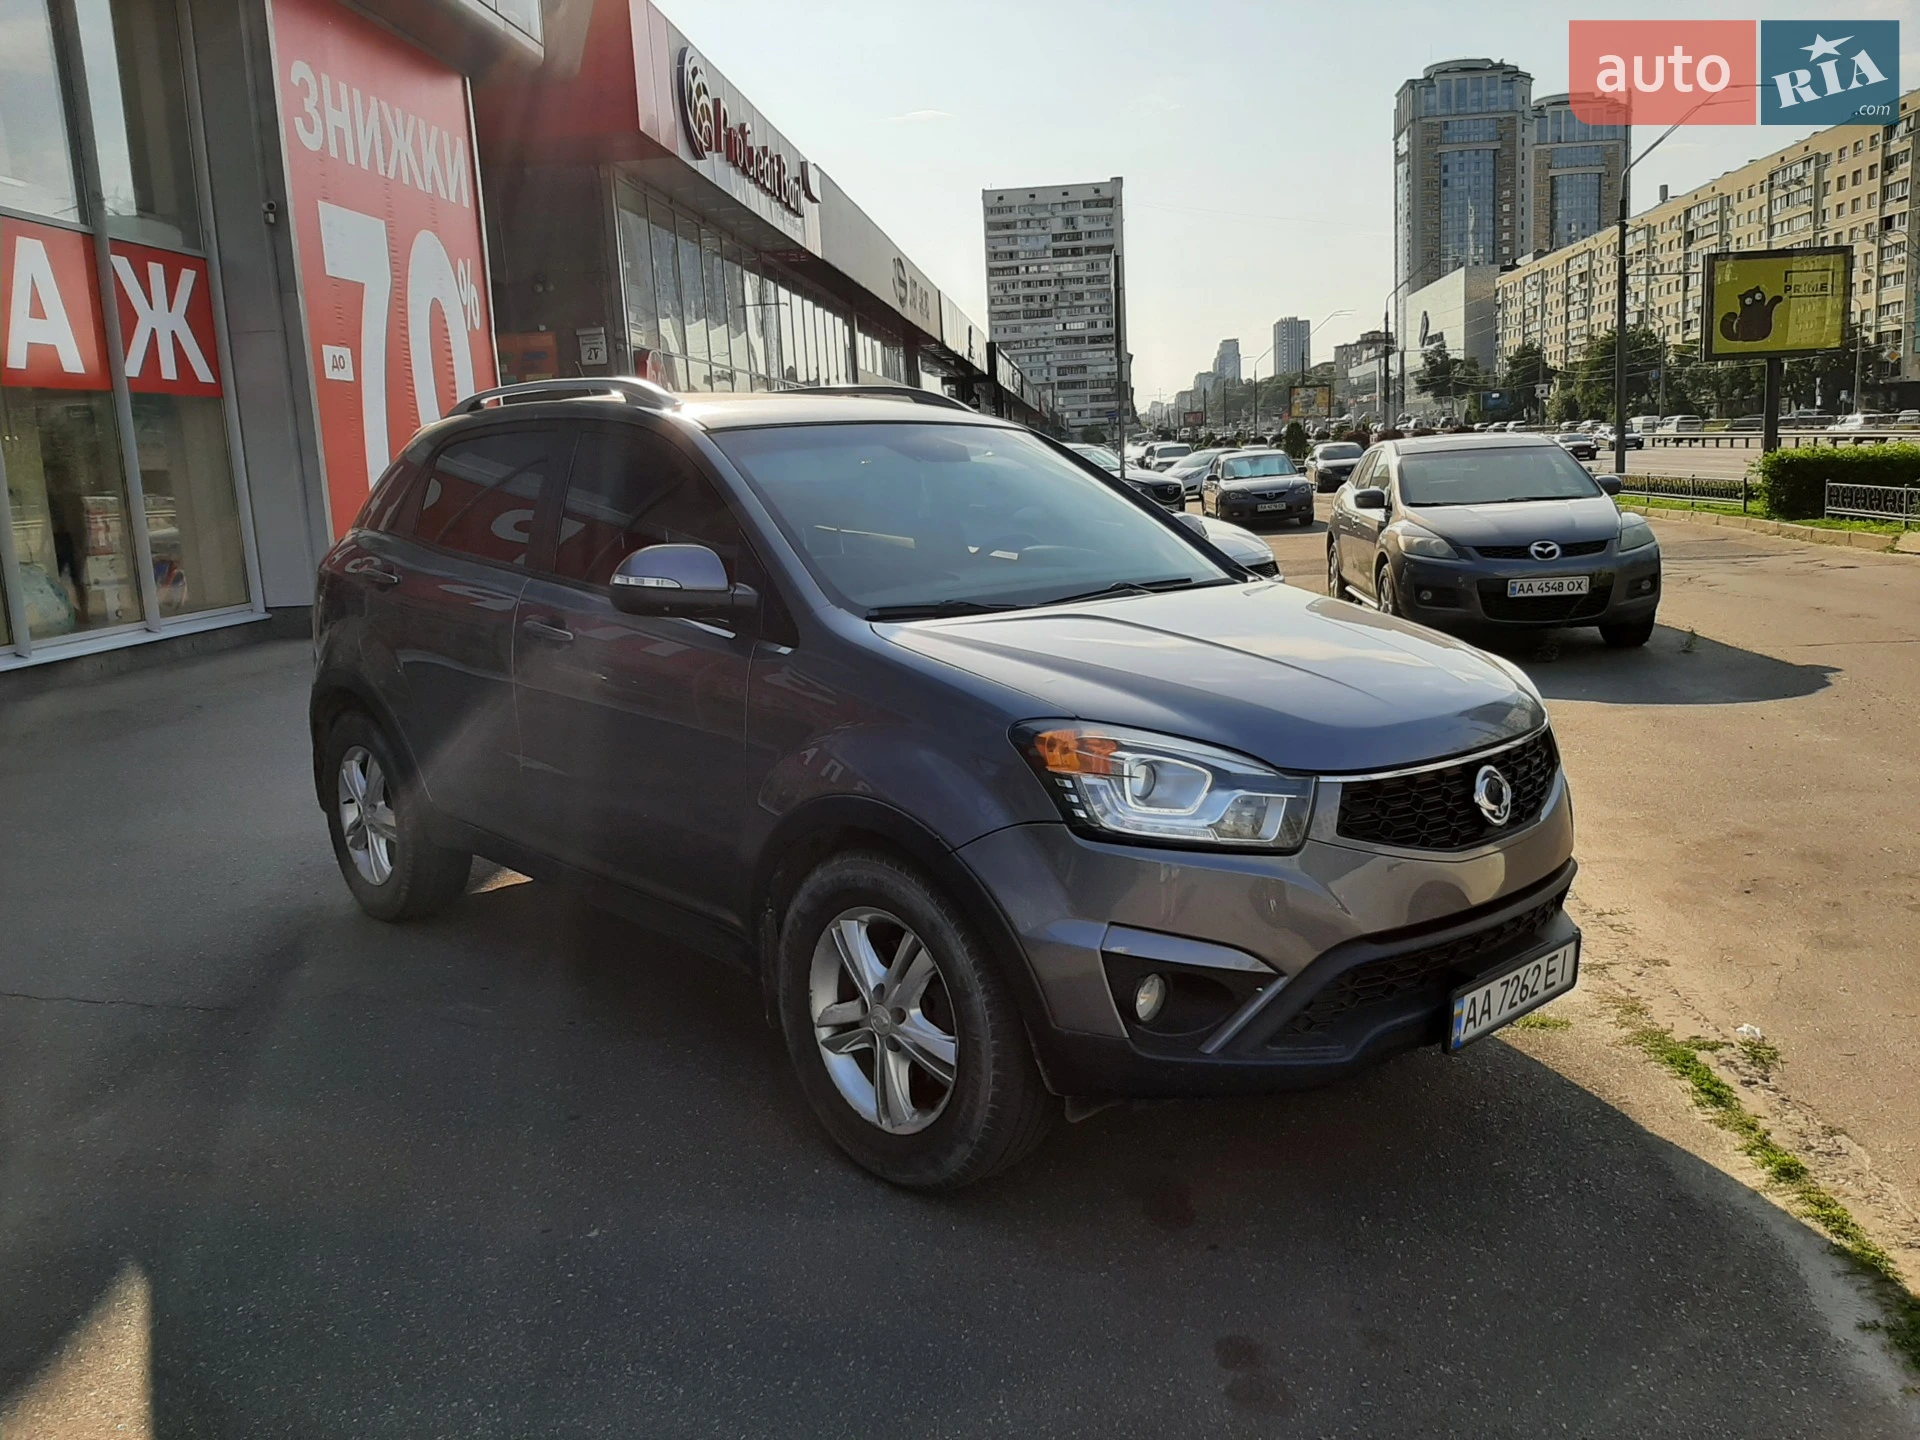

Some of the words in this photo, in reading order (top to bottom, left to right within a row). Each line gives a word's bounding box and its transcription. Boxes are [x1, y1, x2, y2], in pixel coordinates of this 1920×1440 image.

[290, 60, 470, 208] ЗНИЖКИ
[1517, 583, 1534, 594] AA
[1537, 582, 1564, 593] 4548
[1567, 580, 1583, 592] OX
[1463, 988, 1492, 1035] AA
[1497, 963, 1542, 1016] 7262
[1544, 949, 1567, 990] EI
